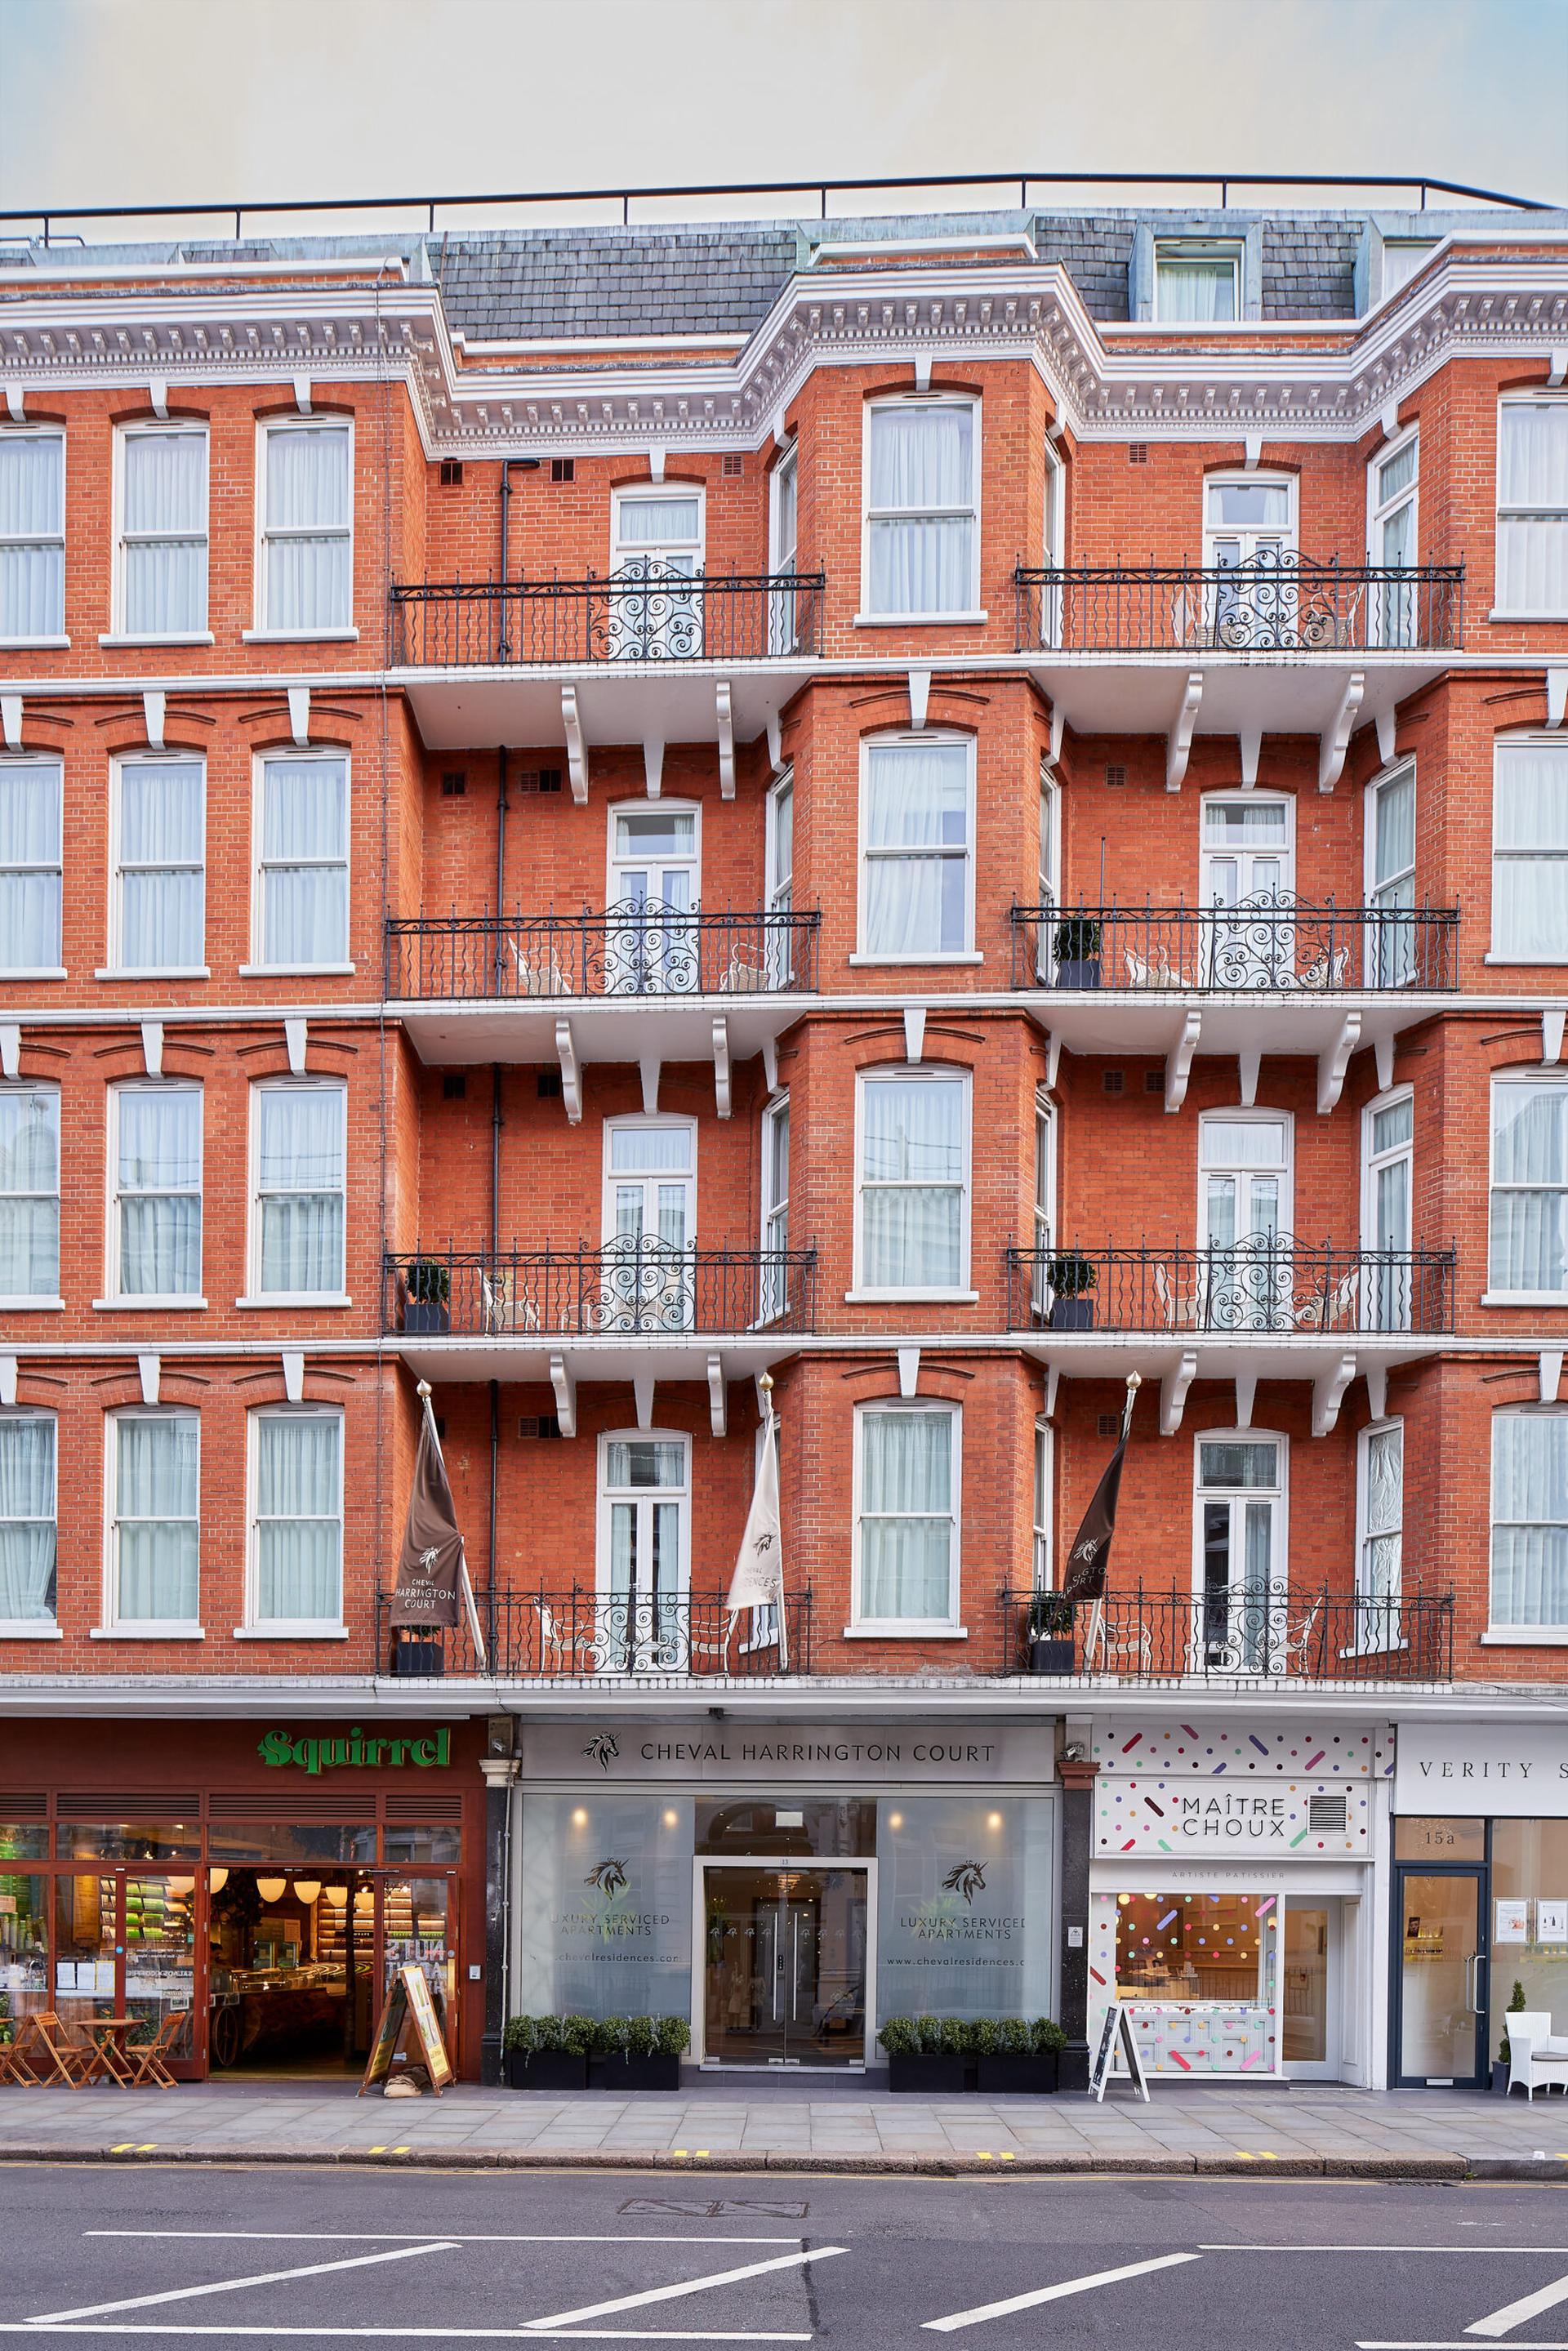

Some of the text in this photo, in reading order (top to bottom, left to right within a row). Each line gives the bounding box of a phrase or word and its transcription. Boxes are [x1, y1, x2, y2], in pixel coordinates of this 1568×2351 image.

[395, 1588, 456, 1600] HARRINGTON
[404, 1599, 436, 1609] COURT
[256, 1726, 451, 1775] Squirrel
[641, 1743, 995, 1761] CHEVAL HARRINGTON COURT
[1419, 1761, 1533, 1779] VERITY
[1183, 1793, 1285, 1815] MAÎTRE
[1183, 1819, 1285, 1837] CHOUX
[1426, 1832, 1454, 1845] 15a
[552, 1913, 670, 1925] UXURY SERVICED
[900, 1917, 956, 1928] LUXURY
[561, 1925, 652, 1936] APARTMENTS
[918, 1929, 1012, 1939] APARTMENTS
[530, 1952, 680, 1962] .chevalresidences.co
[887, 1957, 1024, 1966] www.chevalresidences.c
